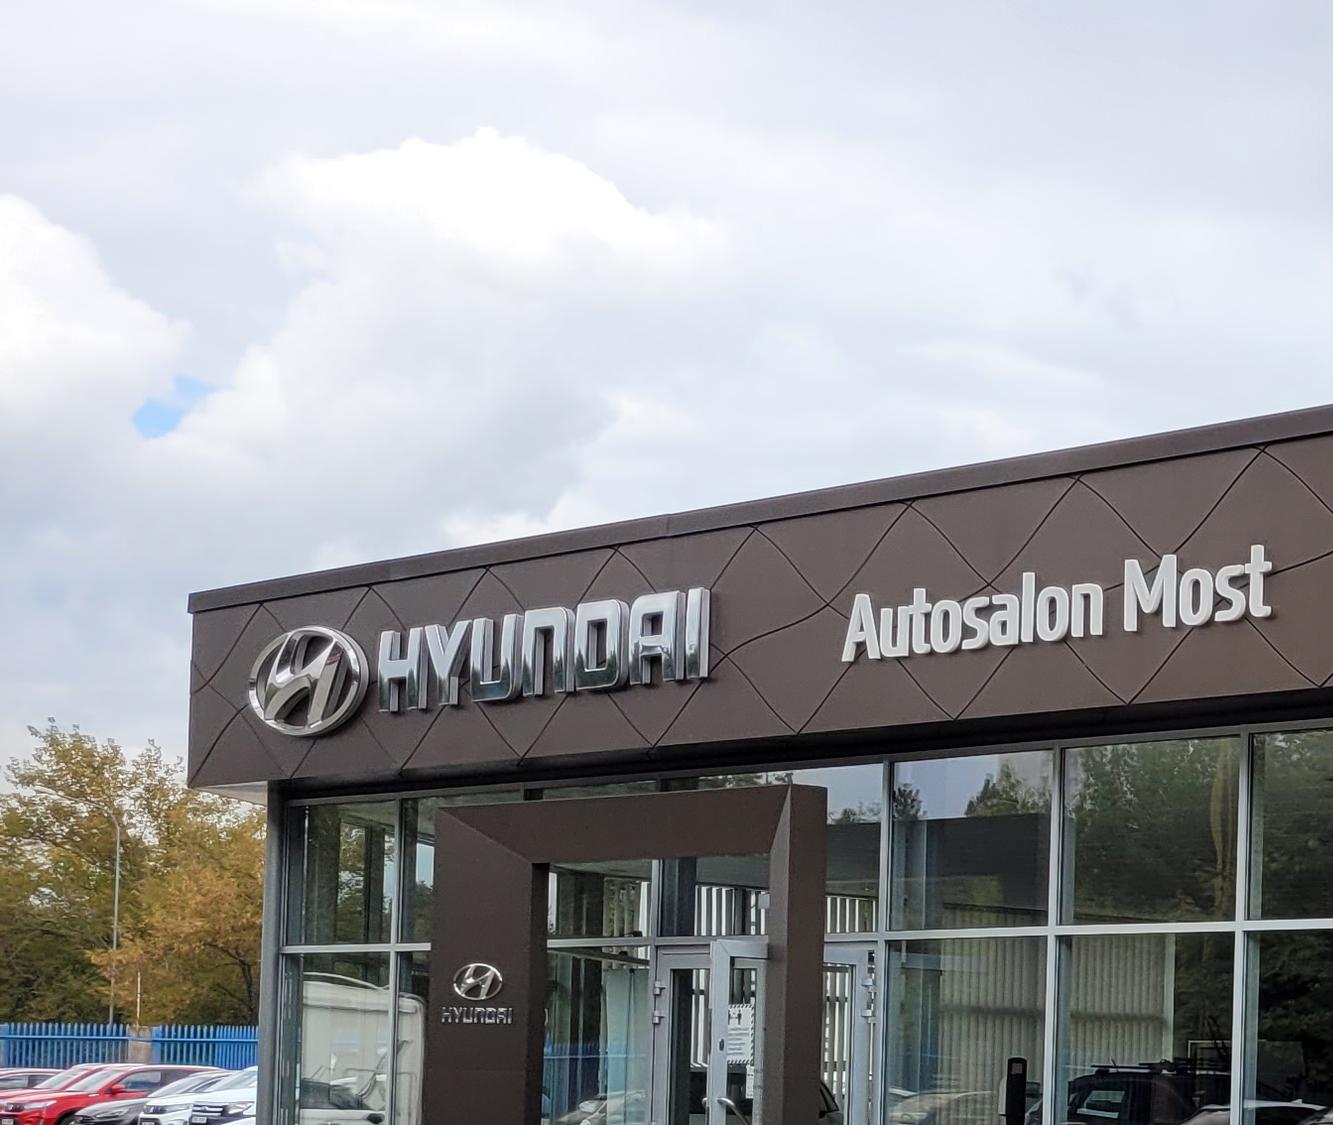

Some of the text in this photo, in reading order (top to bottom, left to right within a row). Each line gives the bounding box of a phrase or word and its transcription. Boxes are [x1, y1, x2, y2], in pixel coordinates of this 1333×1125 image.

[378, 586, 711, 713] HYUNDAI
[841, 543, 1273, 663] Autosalon Most
[441, 1006, 512, 1025] HYUNDAI
